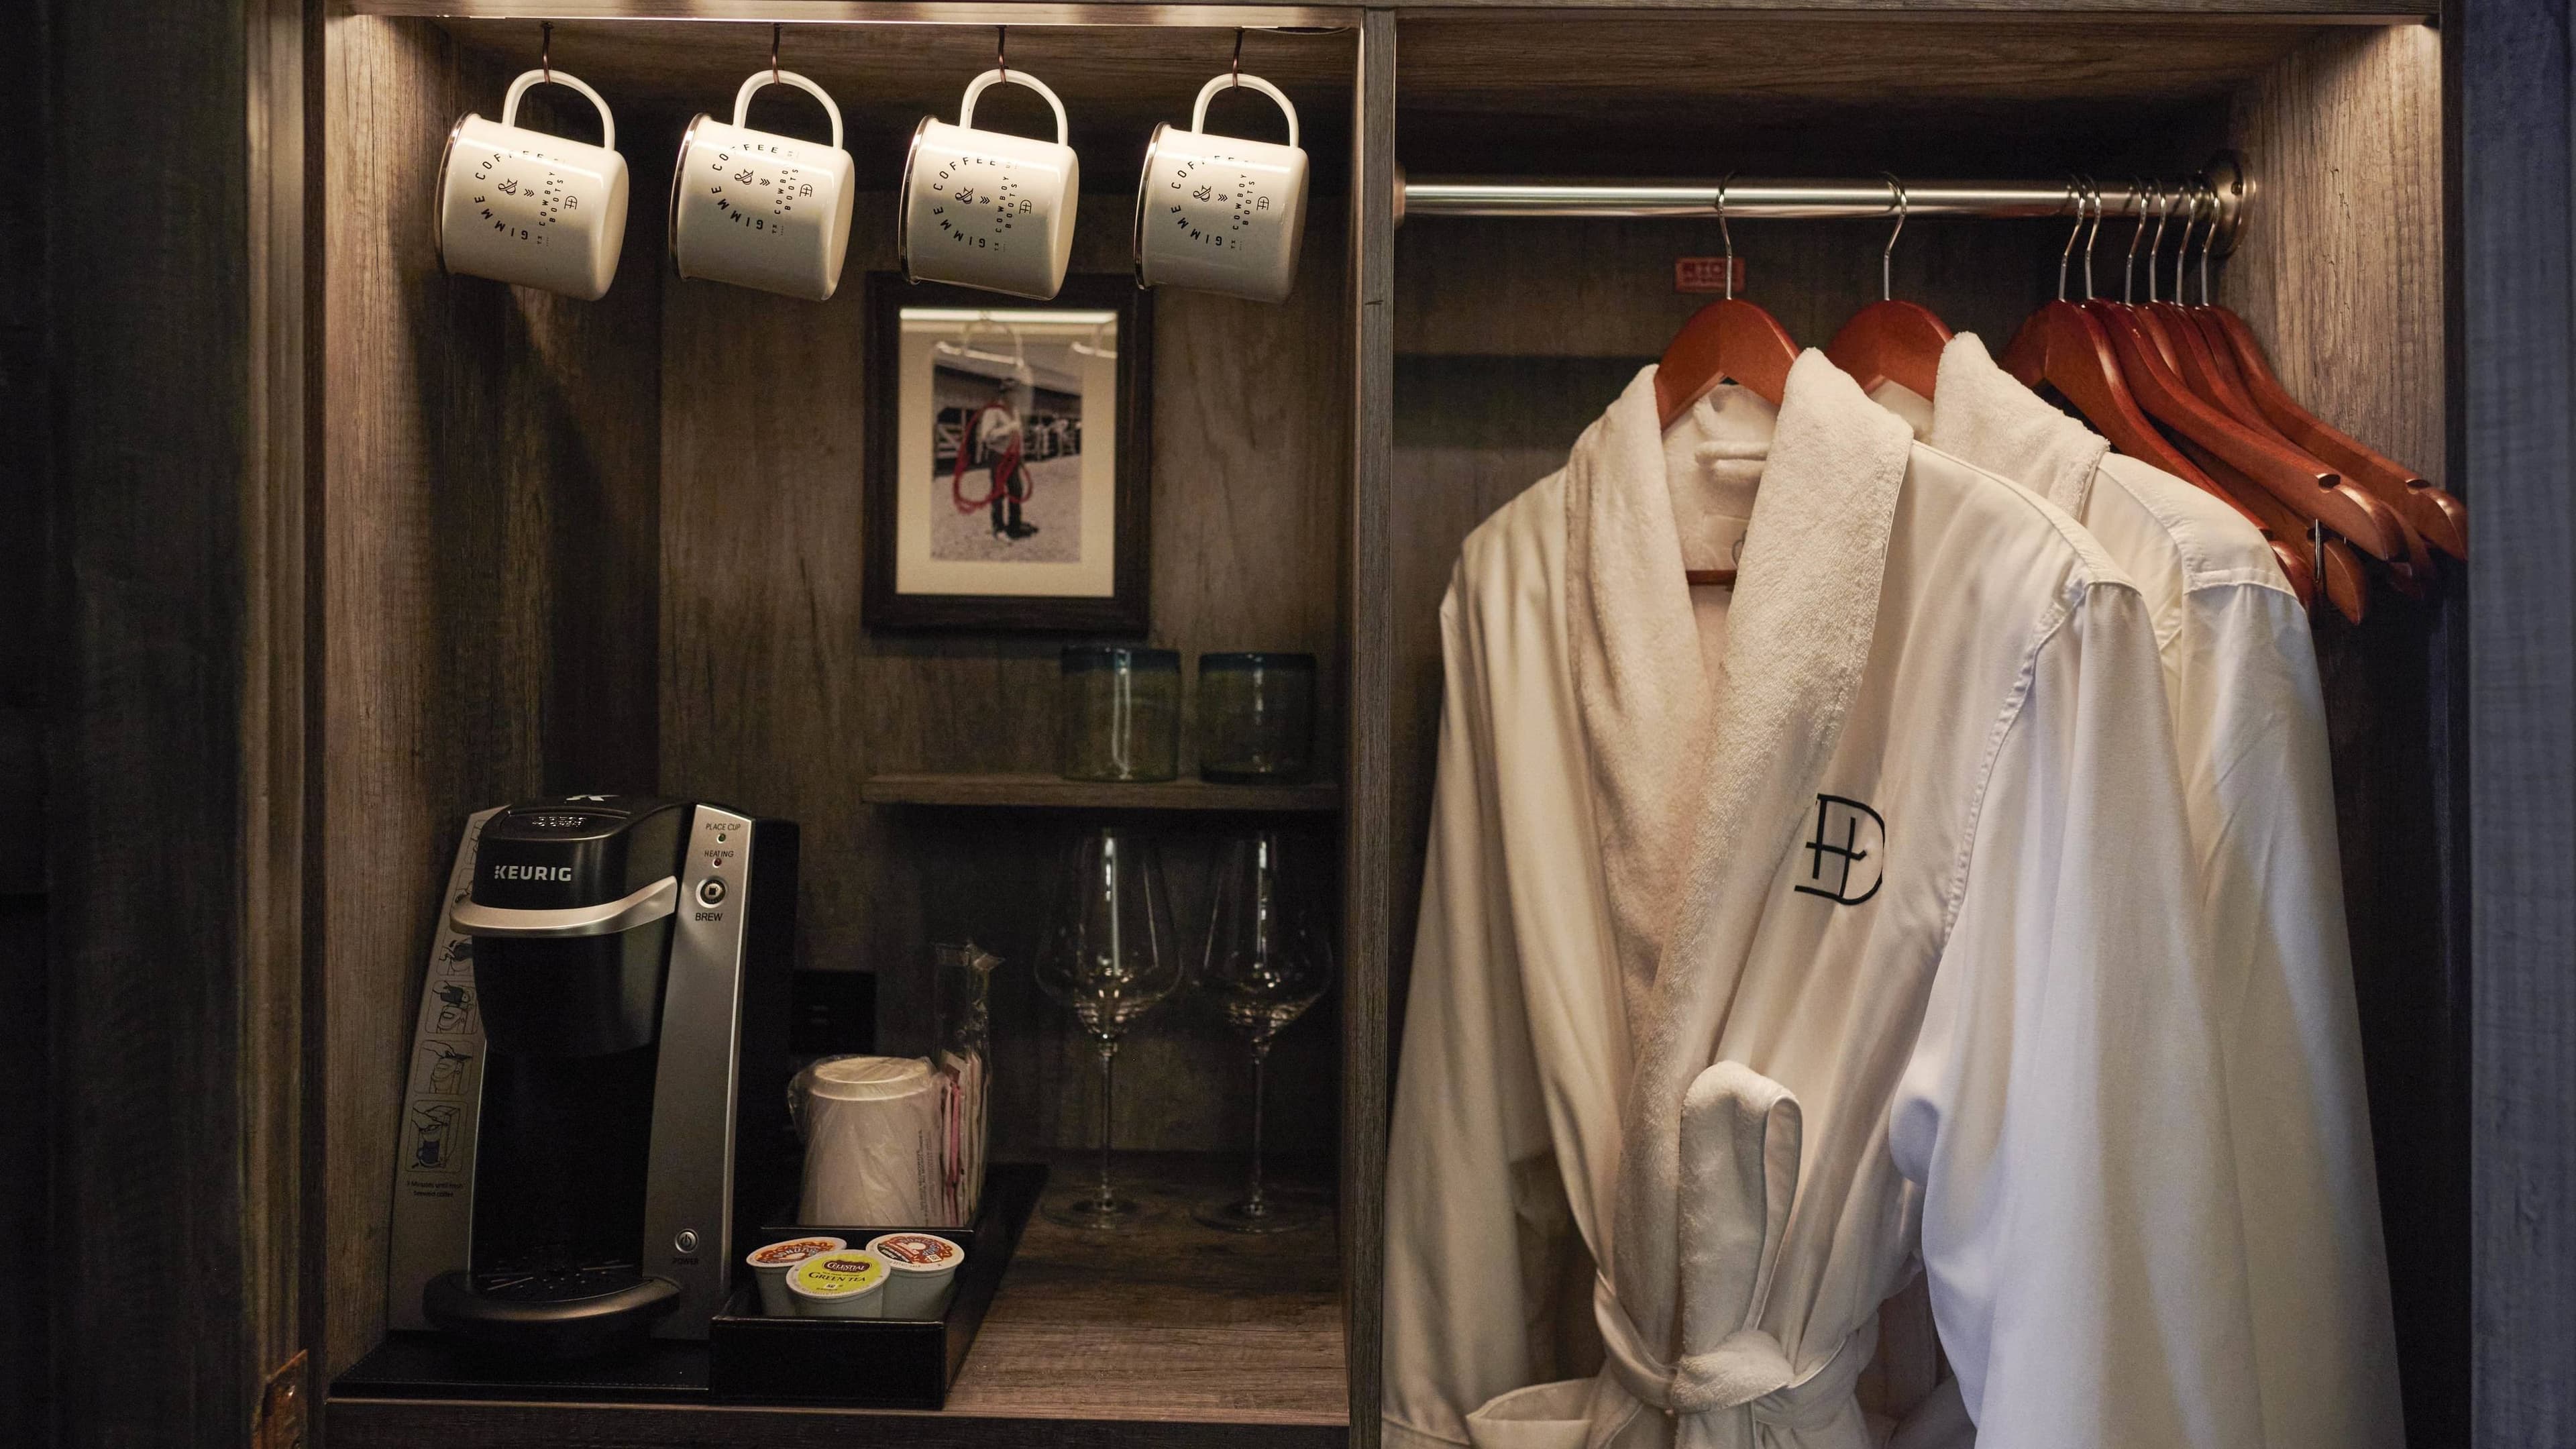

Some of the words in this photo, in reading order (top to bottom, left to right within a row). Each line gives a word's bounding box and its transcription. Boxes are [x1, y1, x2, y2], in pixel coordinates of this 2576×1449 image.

[712, 144, 778, 171] COFEE
[735, 168, 753, 185] &
[1171, 155, 1235, 189] COF
[498, 178, 518, 196] &
[539, 172, 555, 226] COWBOY
[549, 179, 564, 223] BOOTS
[711, 186, 763, 229] GIMME
[774, 170, 789, 215] COWBO
[784, 169, 798, 211] BOOTS
[955, 187, 973, 205] &
[995, 176, 1009, 233] COWBOY
[1005, 183, 1017, 228] BOOTS
[1193, 185, 1212, 202] &
[1232, 174, 1246, 230] COWBOY
[1242, 181, 1254, 225] BOOTS
[474, 195, 528, 240] GIMME
[933, 207, 985, 248] GIMME
[1171, 205, 1222, 246] GIMME
[494, 865, 572, 881] KEURIG
[695, 912, 722, 922] BREW
[808, 1272, 846, 1281] GREEN
